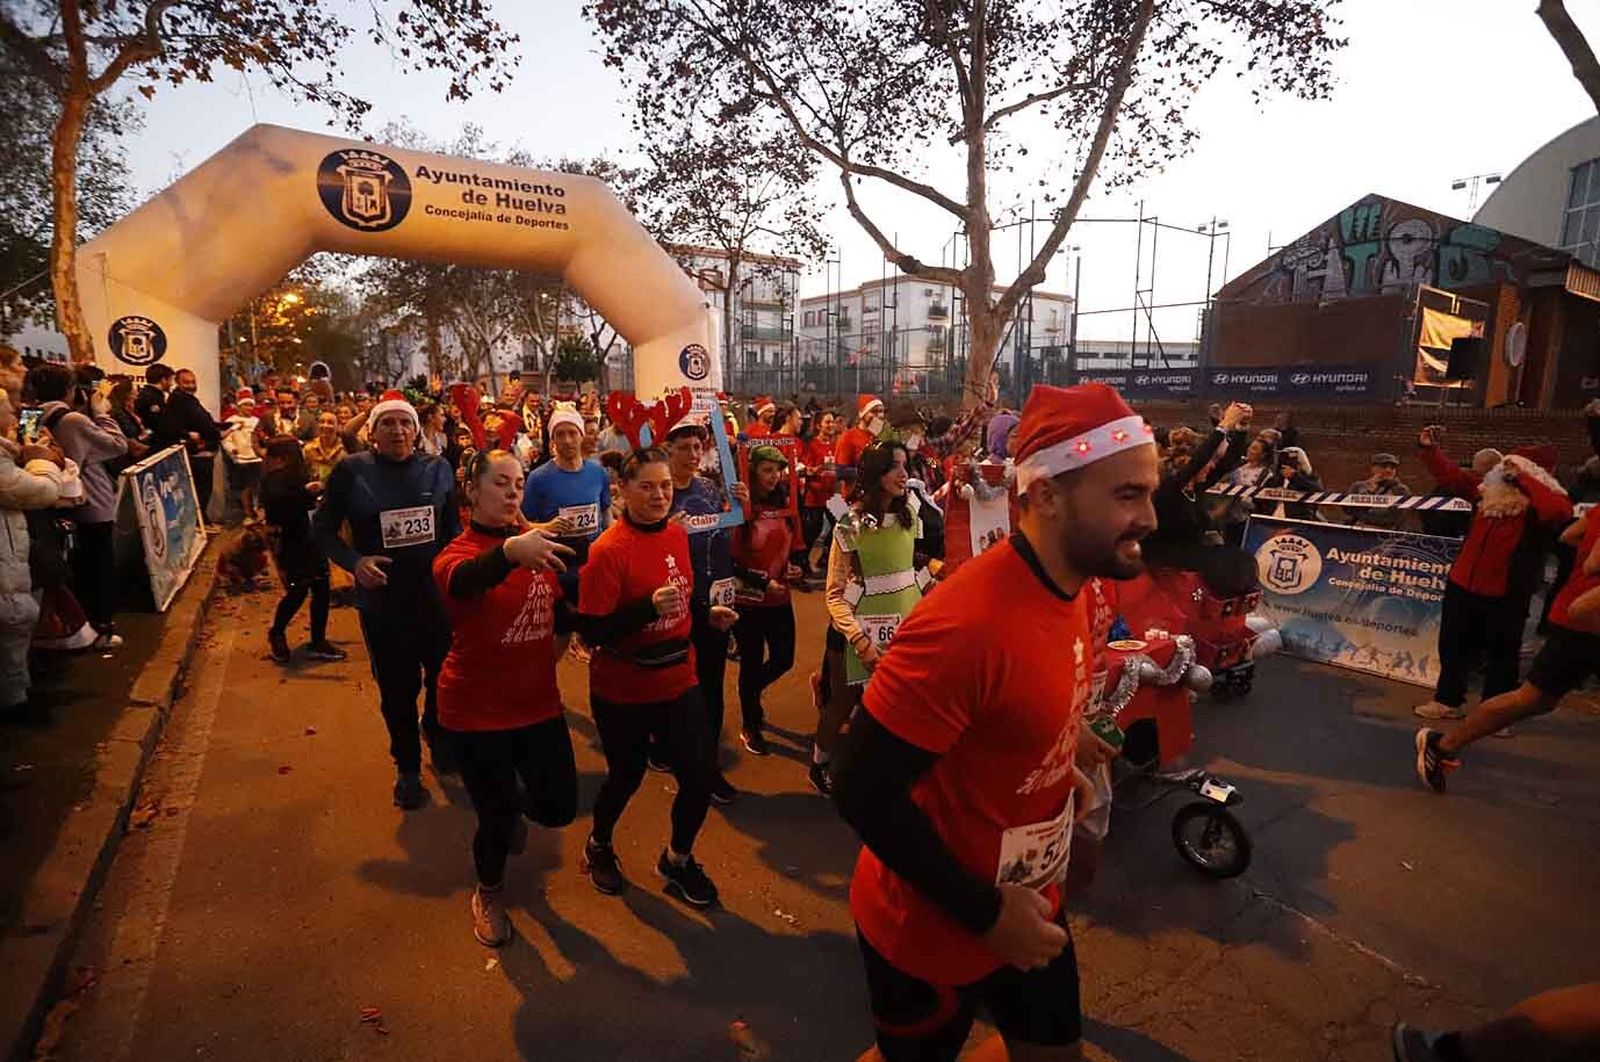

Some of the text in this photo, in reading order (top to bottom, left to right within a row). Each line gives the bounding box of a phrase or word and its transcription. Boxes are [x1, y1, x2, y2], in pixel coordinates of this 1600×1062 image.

[416, 166, 566, 198] Ayuntamiento
[462, 189, 567, 215] de Huelva
[497, 214, 512, 223] de
[515, 215, 570, 231] Deportes
[1231, 374, 1278, 384] HYUNDAI
[1312, 373, 1368, 383] HYUNDAI
[404, 518, 430, 534] 233
[577, 513, 595, 528] 234
[1359, 567, 1384, 581] de
[1389, 585, 1403, 595] de
